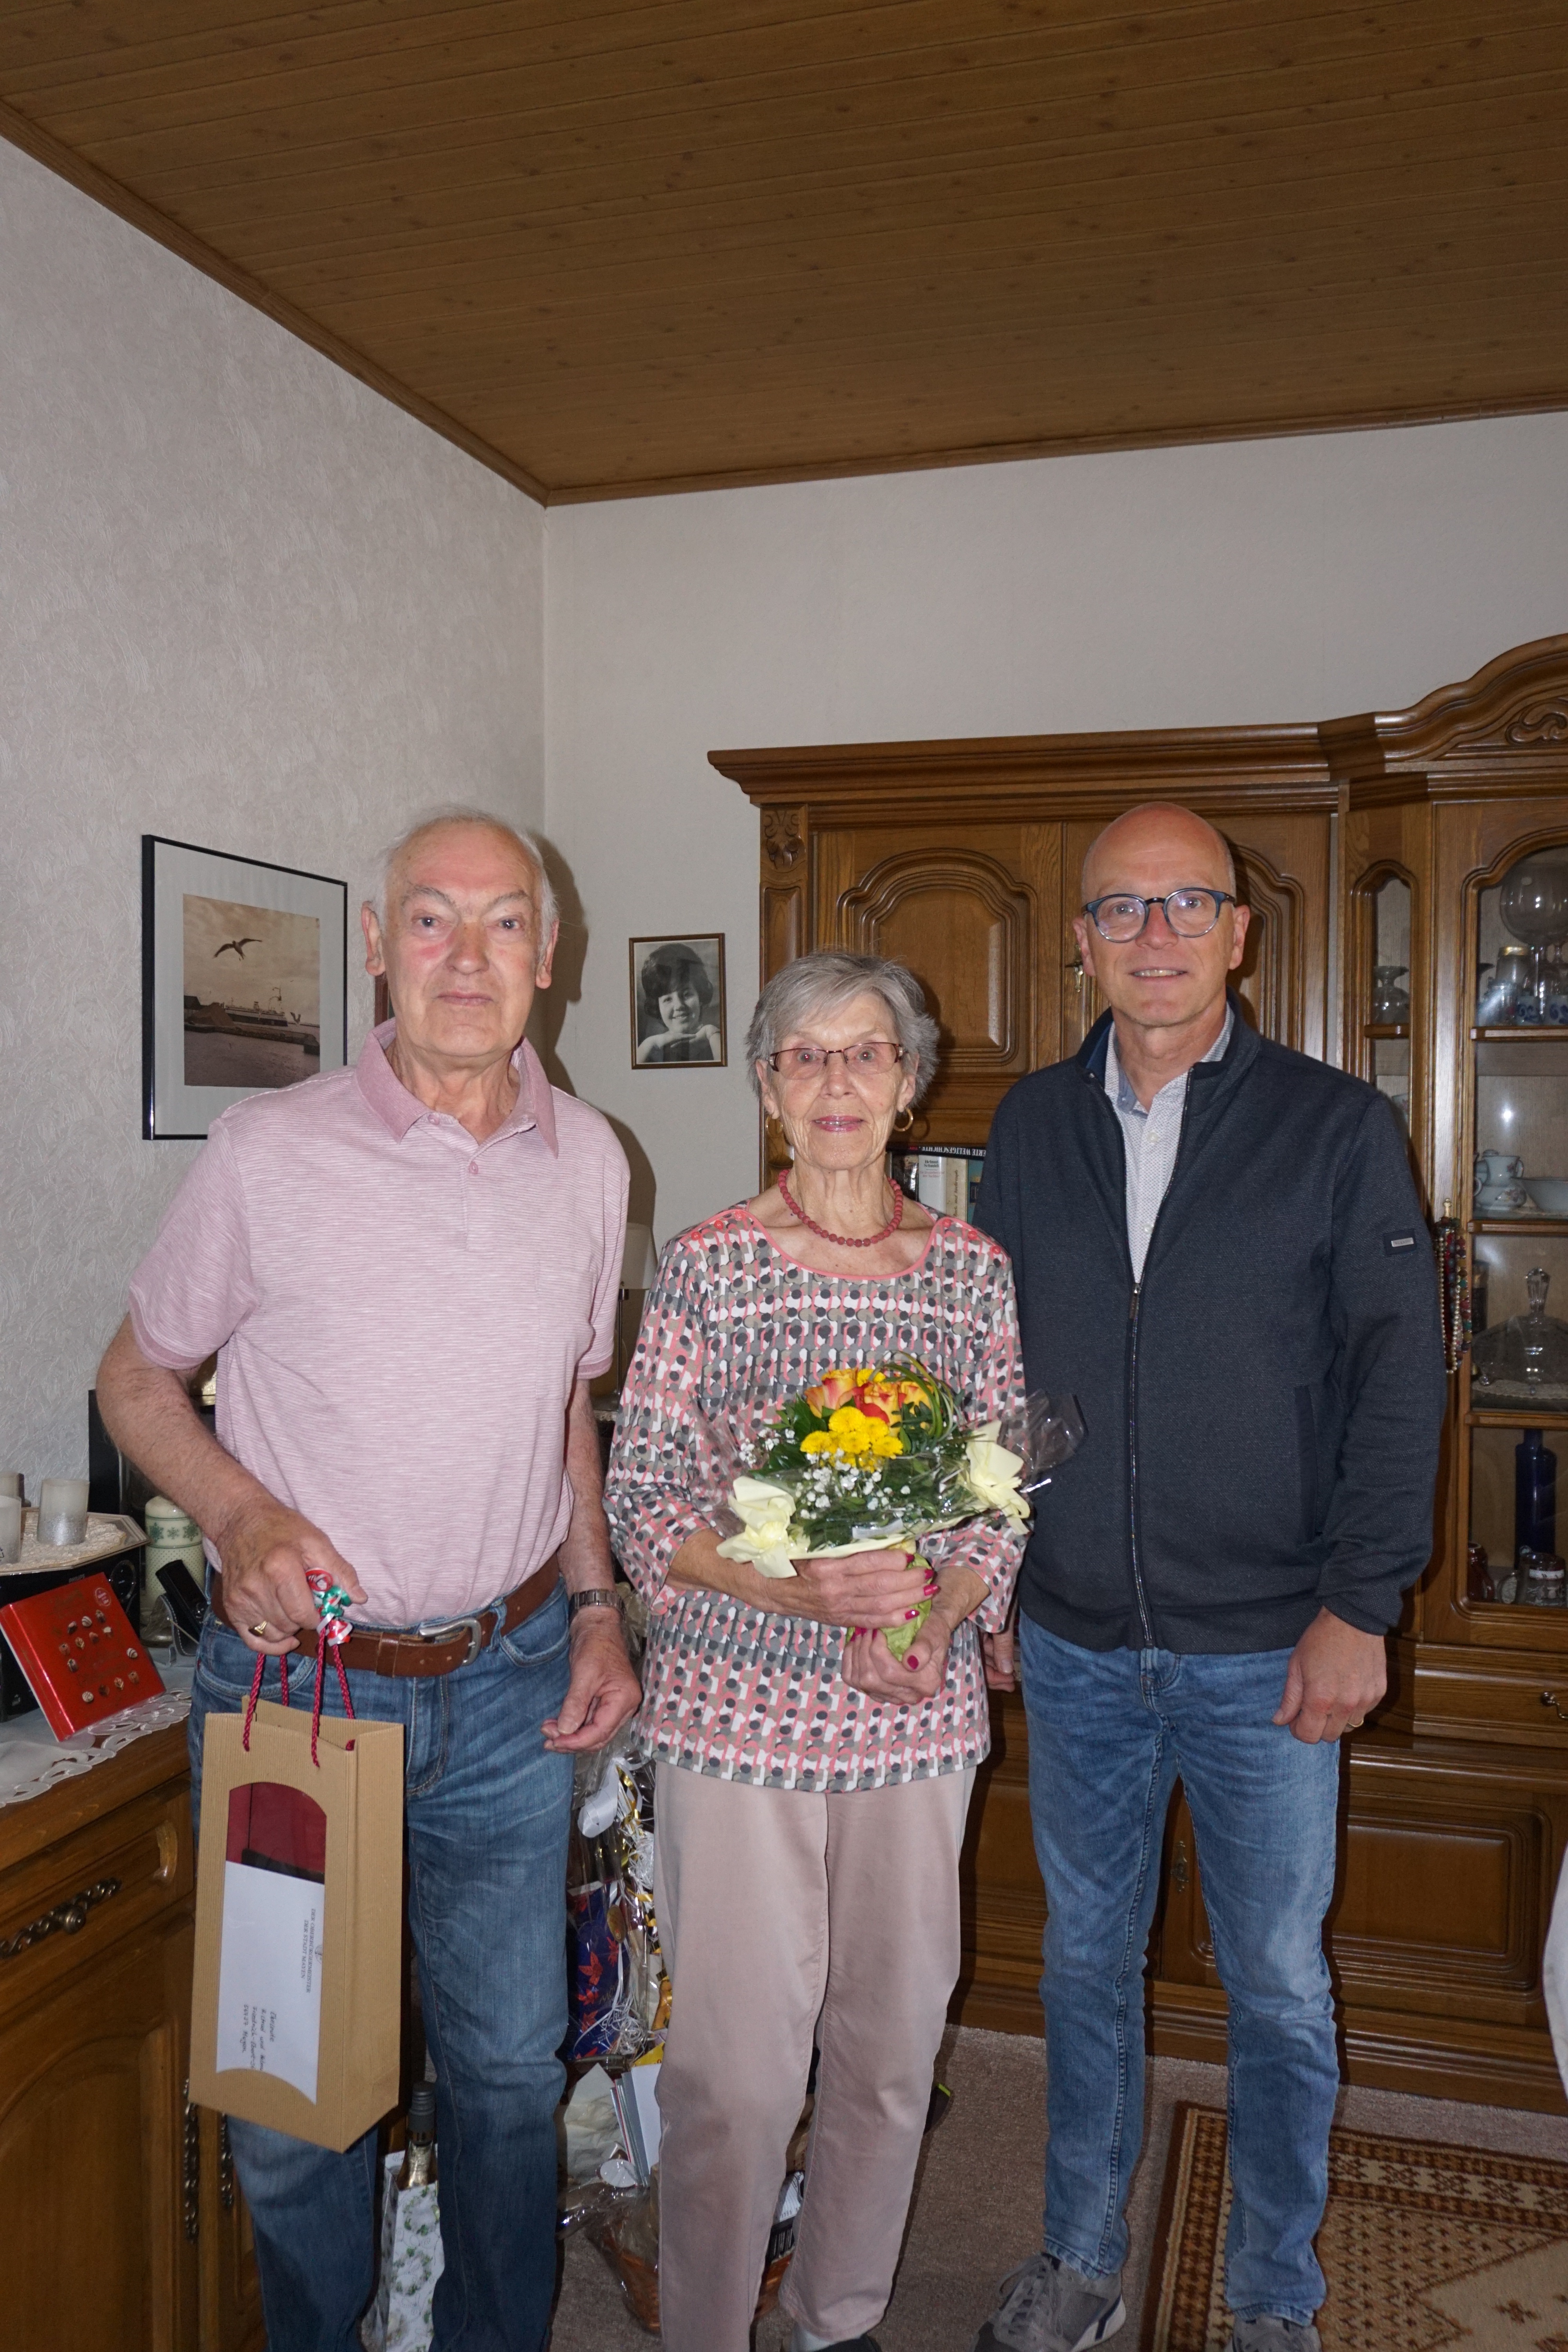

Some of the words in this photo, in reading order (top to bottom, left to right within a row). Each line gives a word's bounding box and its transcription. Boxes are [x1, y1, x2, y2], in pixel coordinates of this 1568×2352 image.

[922, 1147, 971, 1155] WELTGESCHICHTE
[69, 1574, 85, 1583] PHILIPS
[306, 1923, 315, 1993] OBERBÜRGERMEISTER
[239, 2031, 248, 2053] Mayen
